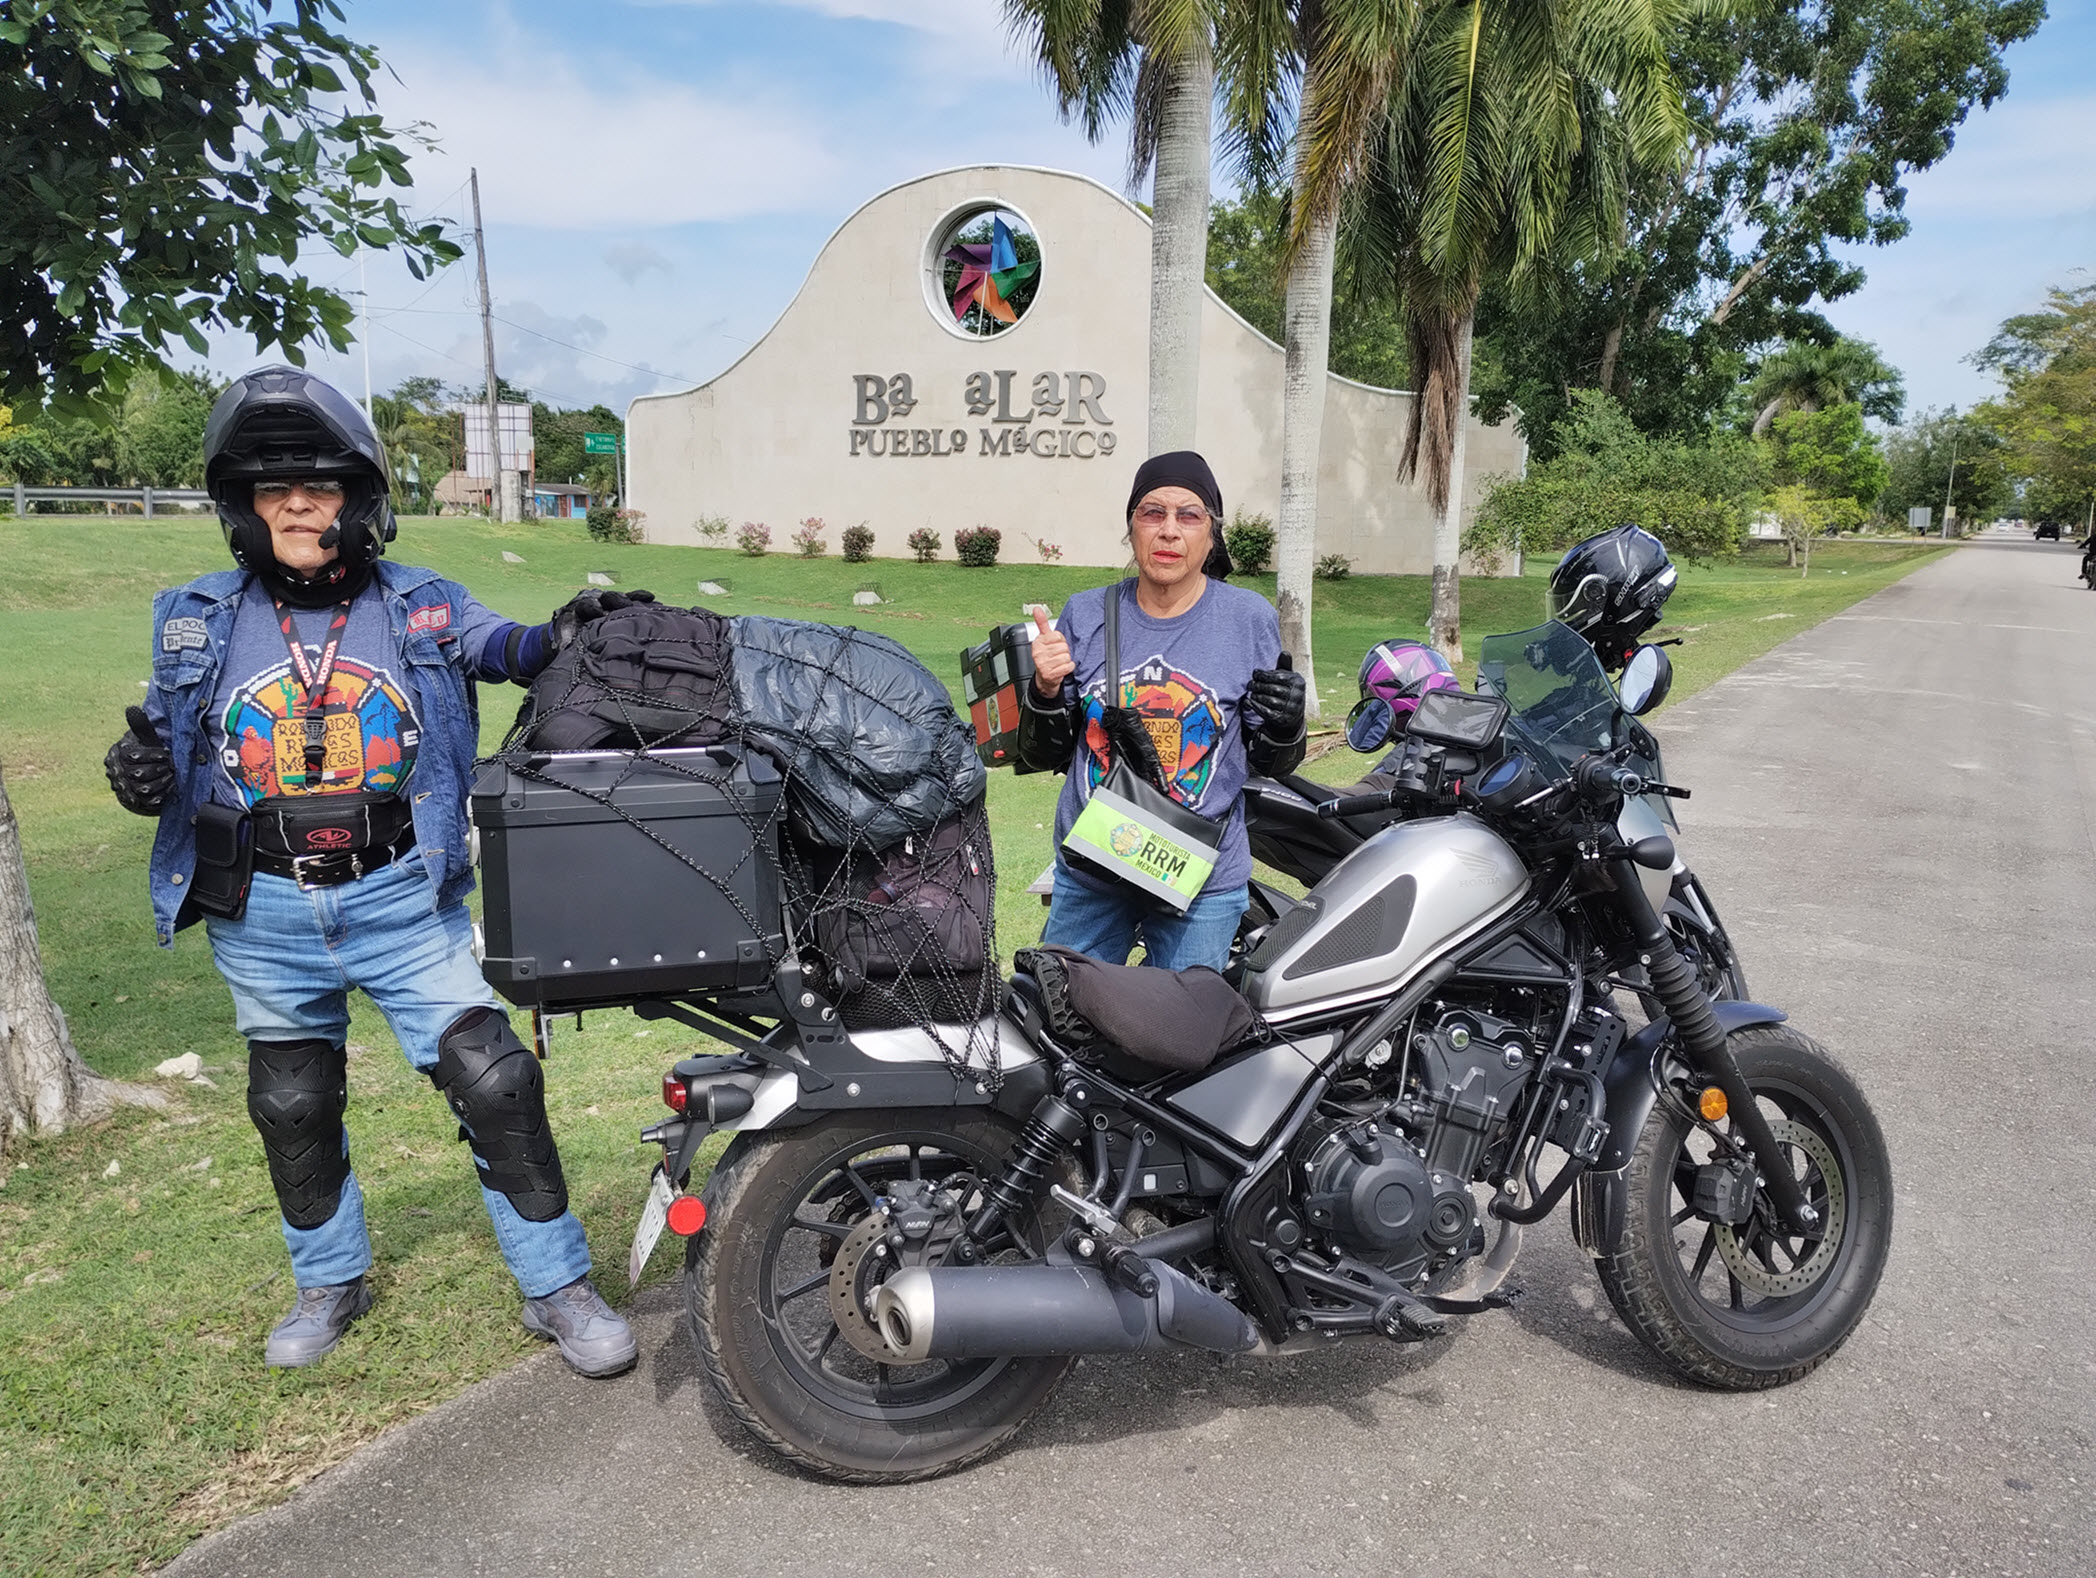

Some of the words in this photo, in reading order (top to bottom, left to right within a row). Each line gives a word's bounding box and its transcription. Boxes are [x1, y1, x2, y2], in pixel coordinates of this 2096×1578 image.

[289, 641, 313, 689] HONDA
[316, 639, 338, 685] HONDA
[402, 729, 419, 747] E
[1140, 841, 1187, 878] RRM
[1149, 832, 1191, 861] MOTOTURISTA
[1135, 858, 1162, 878] MEXICO
